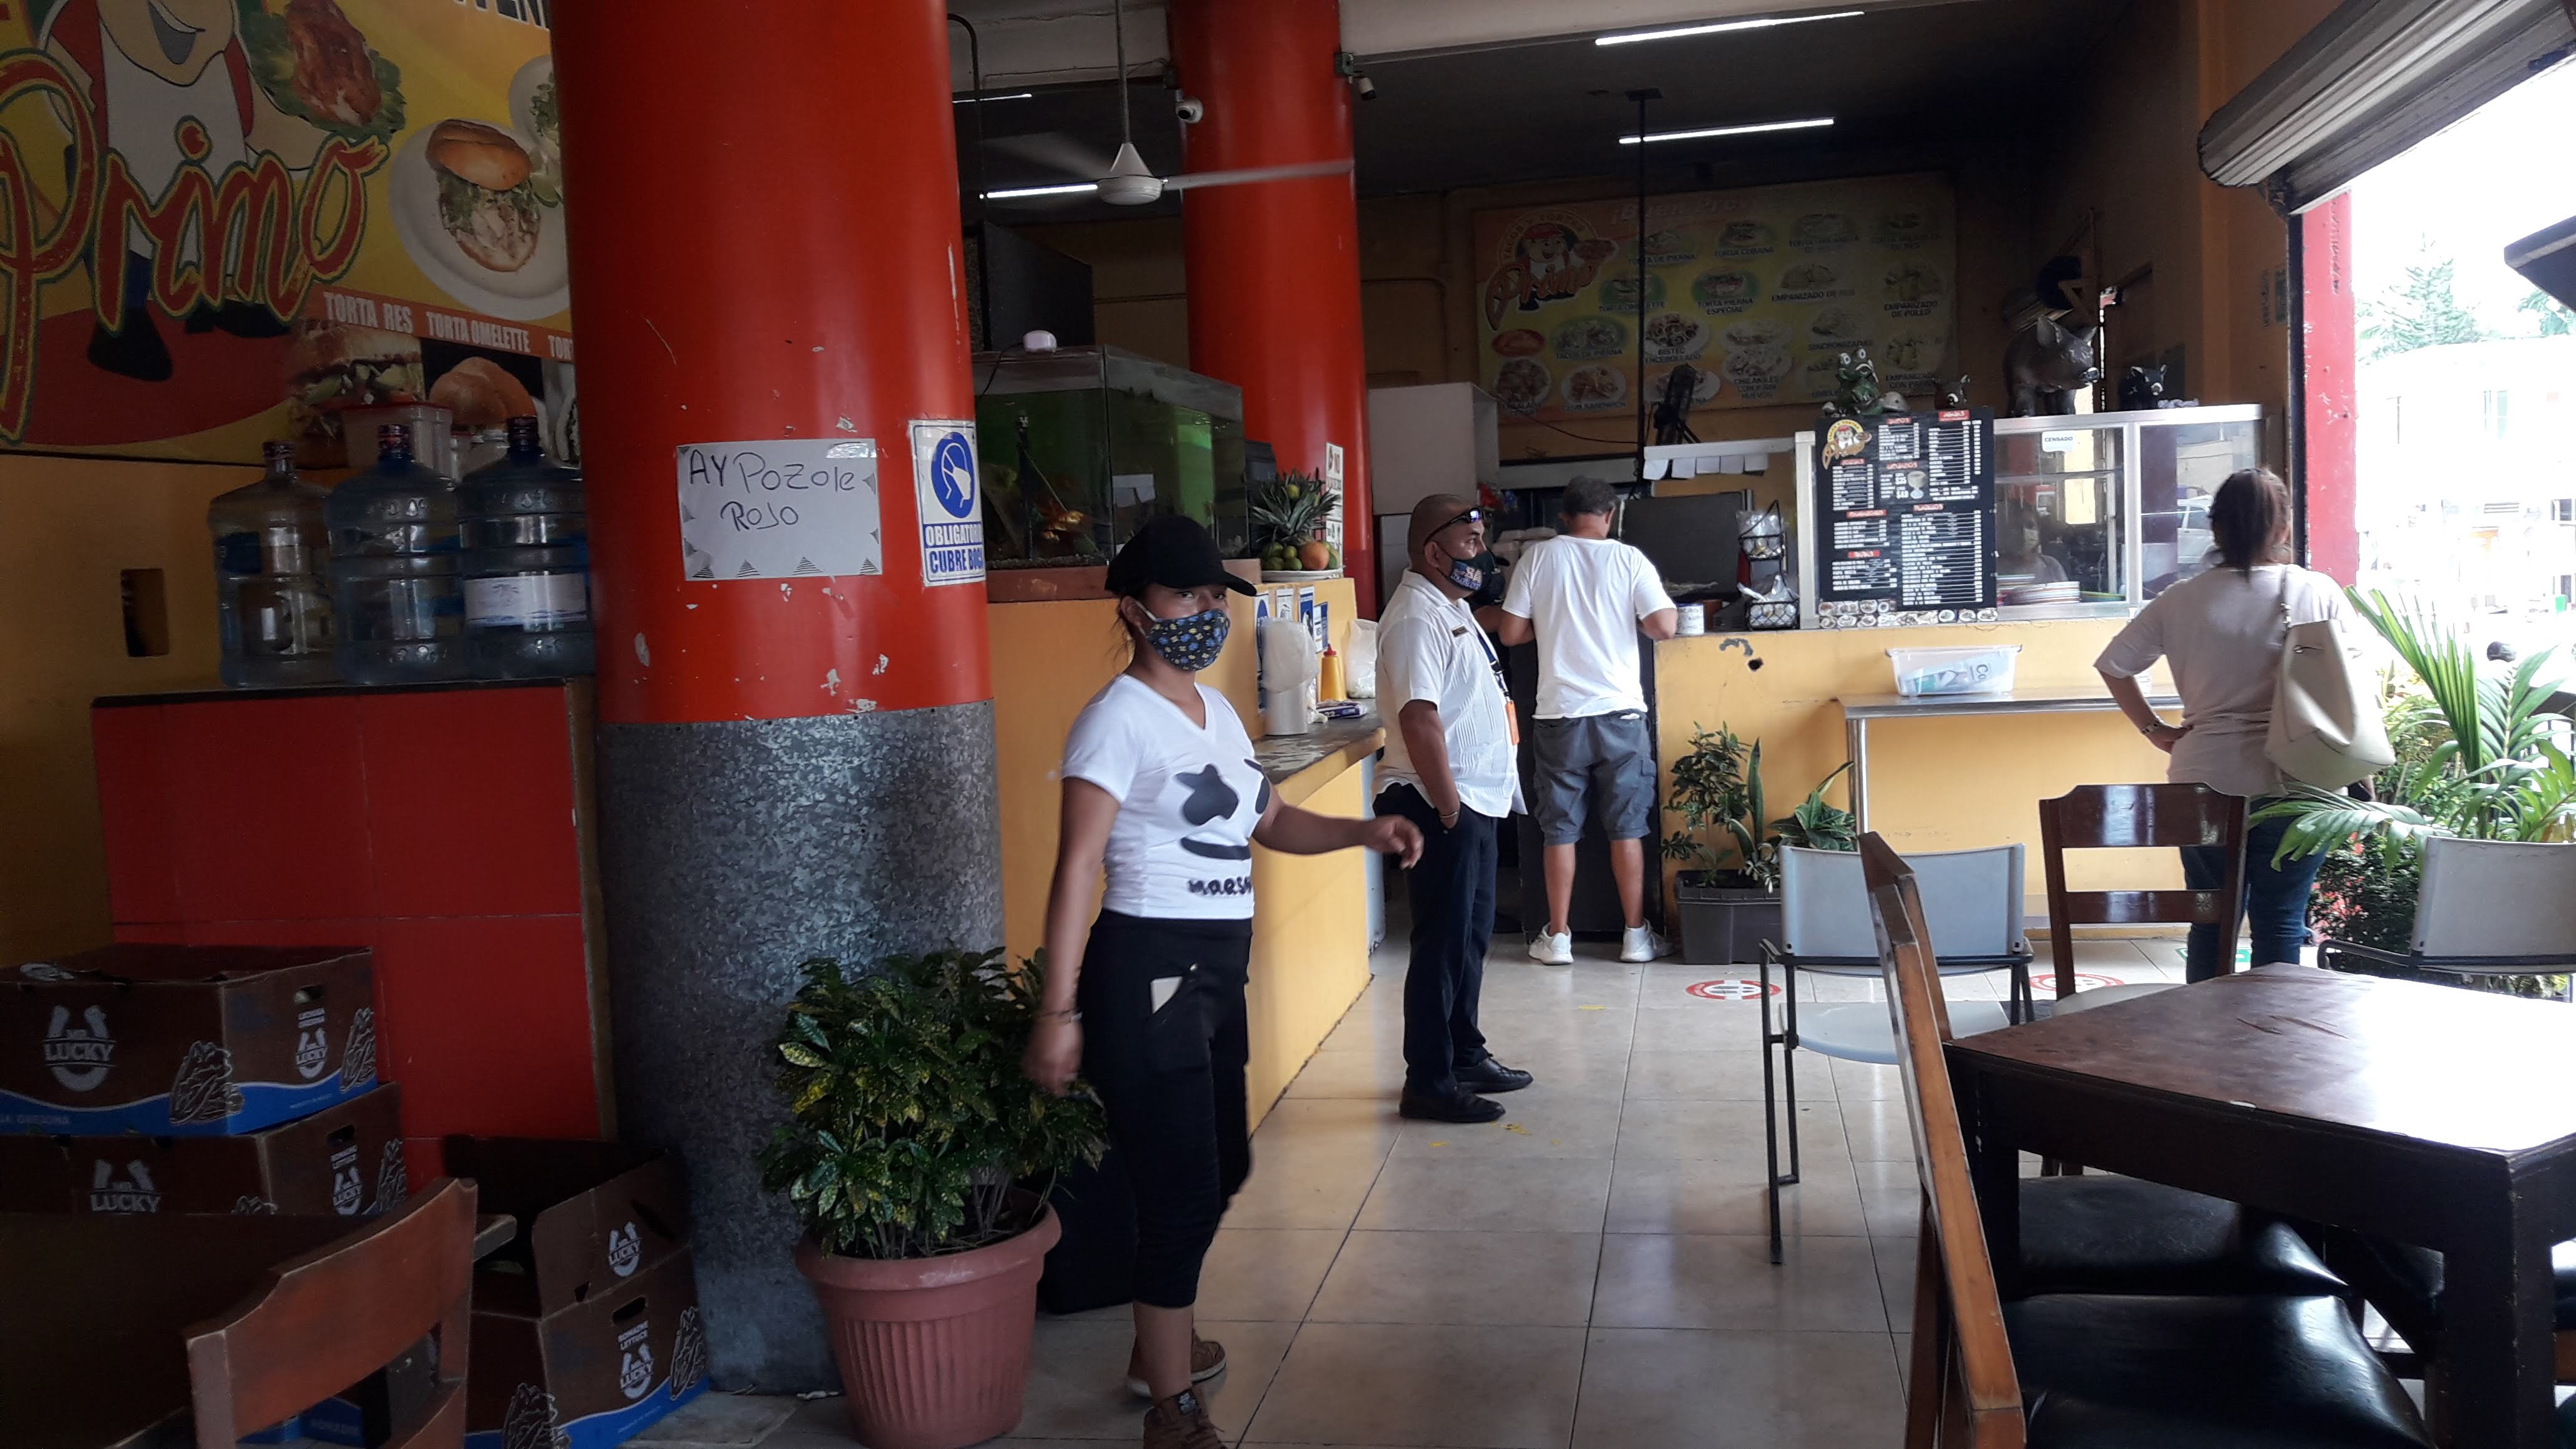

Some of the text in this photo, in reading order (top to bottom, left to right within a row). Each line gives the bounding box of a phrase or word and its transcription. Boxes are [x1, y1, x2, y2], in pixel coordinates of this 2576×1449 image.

[323, 291, 413, 334] TORTA RES
[426, 311, 531, 353] TORTA OMELETTE
[689, 449, 728, 487] AY
[929, 549, 967, 574] CUBRE
[44, 1042, 115, 1061] LUCKY
[89, 1192, 161, 1212] LUCKY
